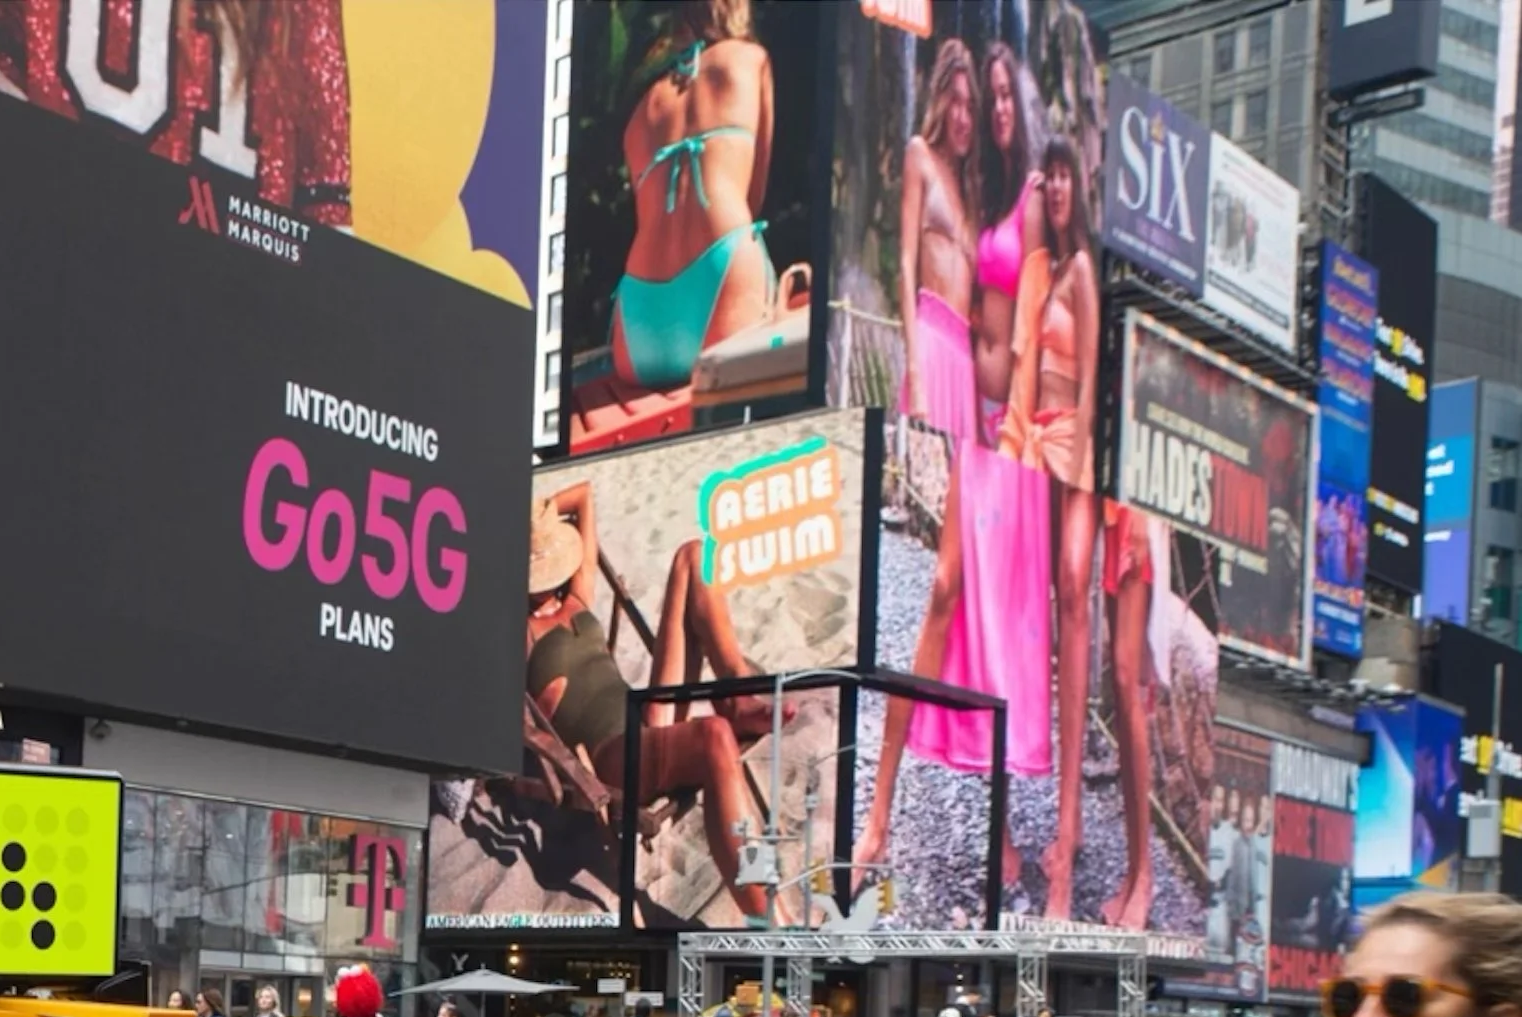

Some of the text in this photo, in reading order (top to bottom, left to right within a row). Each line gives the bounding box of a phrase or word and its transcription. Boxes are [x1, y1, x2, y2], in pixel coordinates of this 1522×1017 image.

[227, 220, 300, 262] MARQUIS
[228, 195, 311, 243] MARRIOTT
[284, 380, 440, 463] INTRODUCING
[242, 436, 469, 614] Go5G
[716, 456, 834, 531] AERIE
[719, 513, 836, 585] SWIM
[319, 602, 395, 652] PLANS
